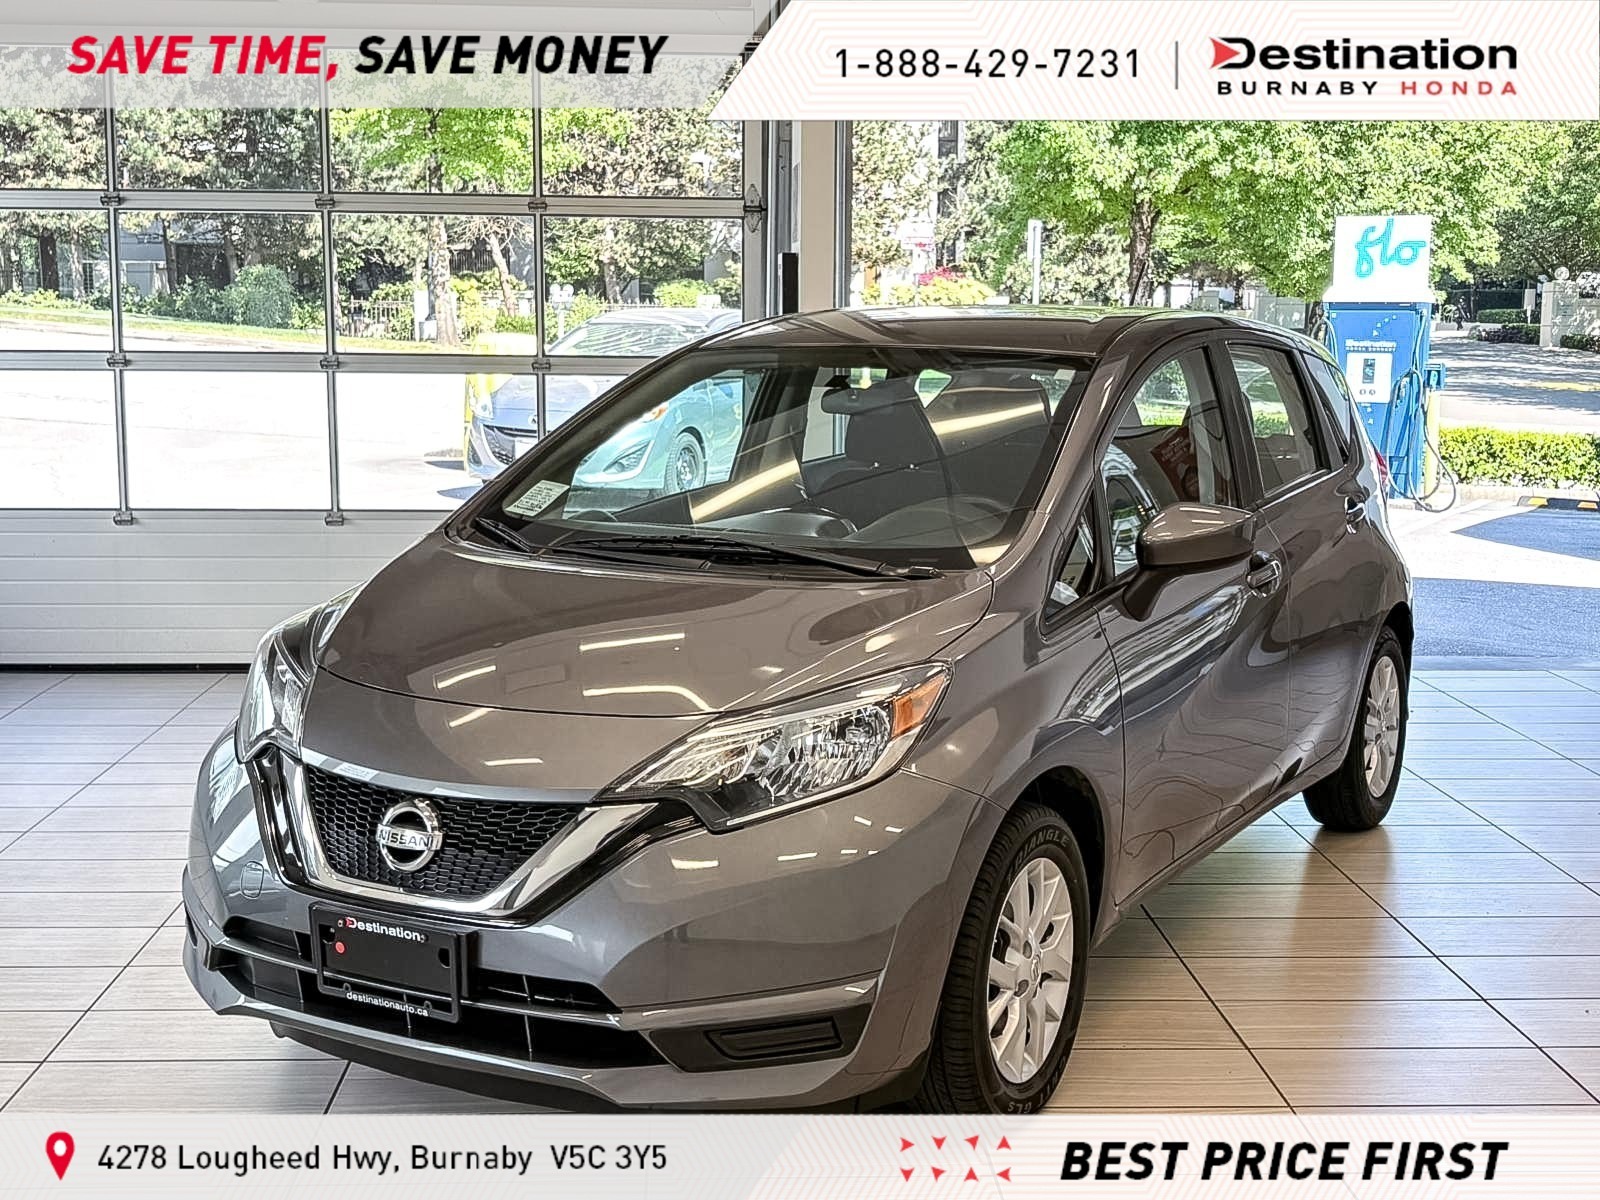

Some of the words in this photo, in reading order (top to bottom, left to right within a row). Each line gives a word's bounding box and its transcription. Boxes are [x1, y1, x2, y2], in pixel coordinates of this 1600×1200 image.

[1355, 218, 1426, 277] flo
[378, 829, 434, 850] NISSAN
[345, 916, 422, 942] Destination
[346, 990, 429, 1017] destinationauto.ca
